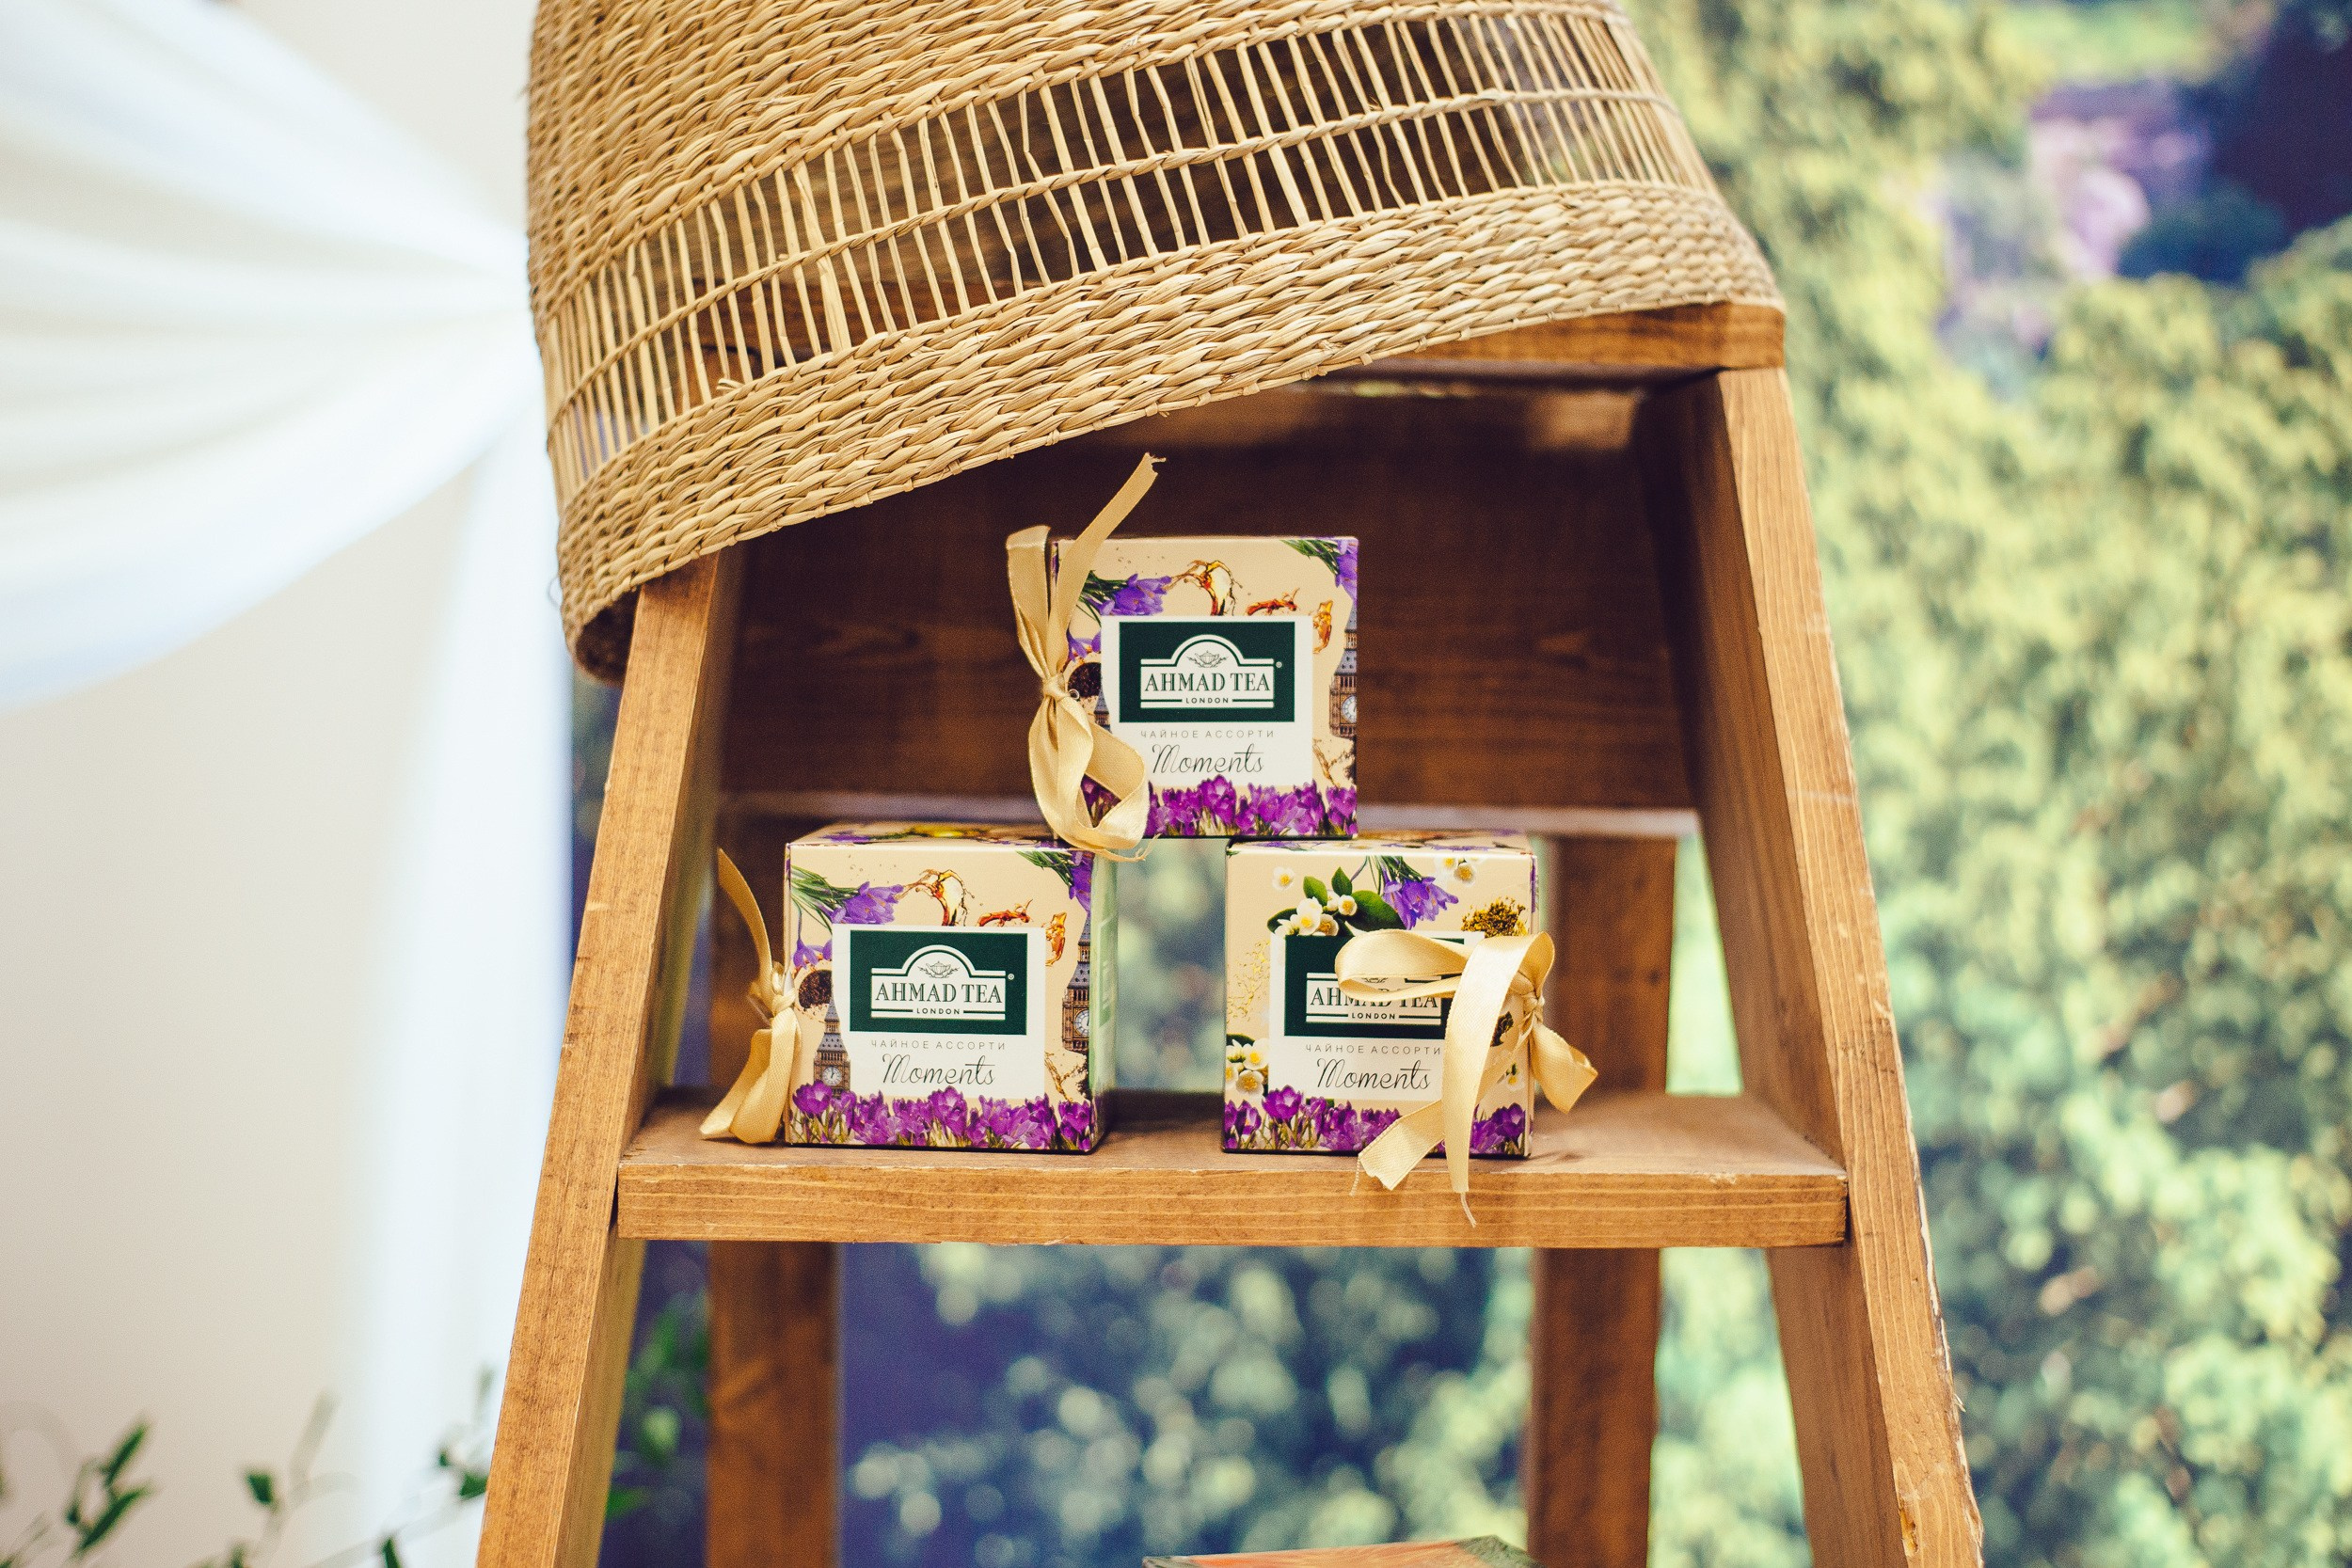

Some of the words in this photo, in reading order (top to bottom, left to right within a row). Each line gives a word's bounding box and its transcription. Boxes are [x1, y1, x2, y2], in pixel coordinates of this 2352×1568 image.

[1144, 673, 1226, 692] AHMAD
[1230, 673, 1271, 692] TEA
[1140, 729, 1199, 738] ЧАЙНОЕ
[1205, 730, 1275, 738] АССОРТИ
[1152, 743, 1264, 774] Moments
[875, 982, 957, 1003] AHMAD
[961, 984, 1003, 1004] TEA
[1310, 987, 1392, 1007] AHM
[871, 1039, 930, 1050] ЧАЙНОЕ
[935, 1040, 1006, 1051] АССОРТИ
[1305, 1043, 1364, 1053] ЧАЙНОЕ
[1370, 1045, 1441, 1055] АССОРТИ
[882, 1053, 996, 1085] Moments
[1316, 1057, 1432, 1090] Moments
